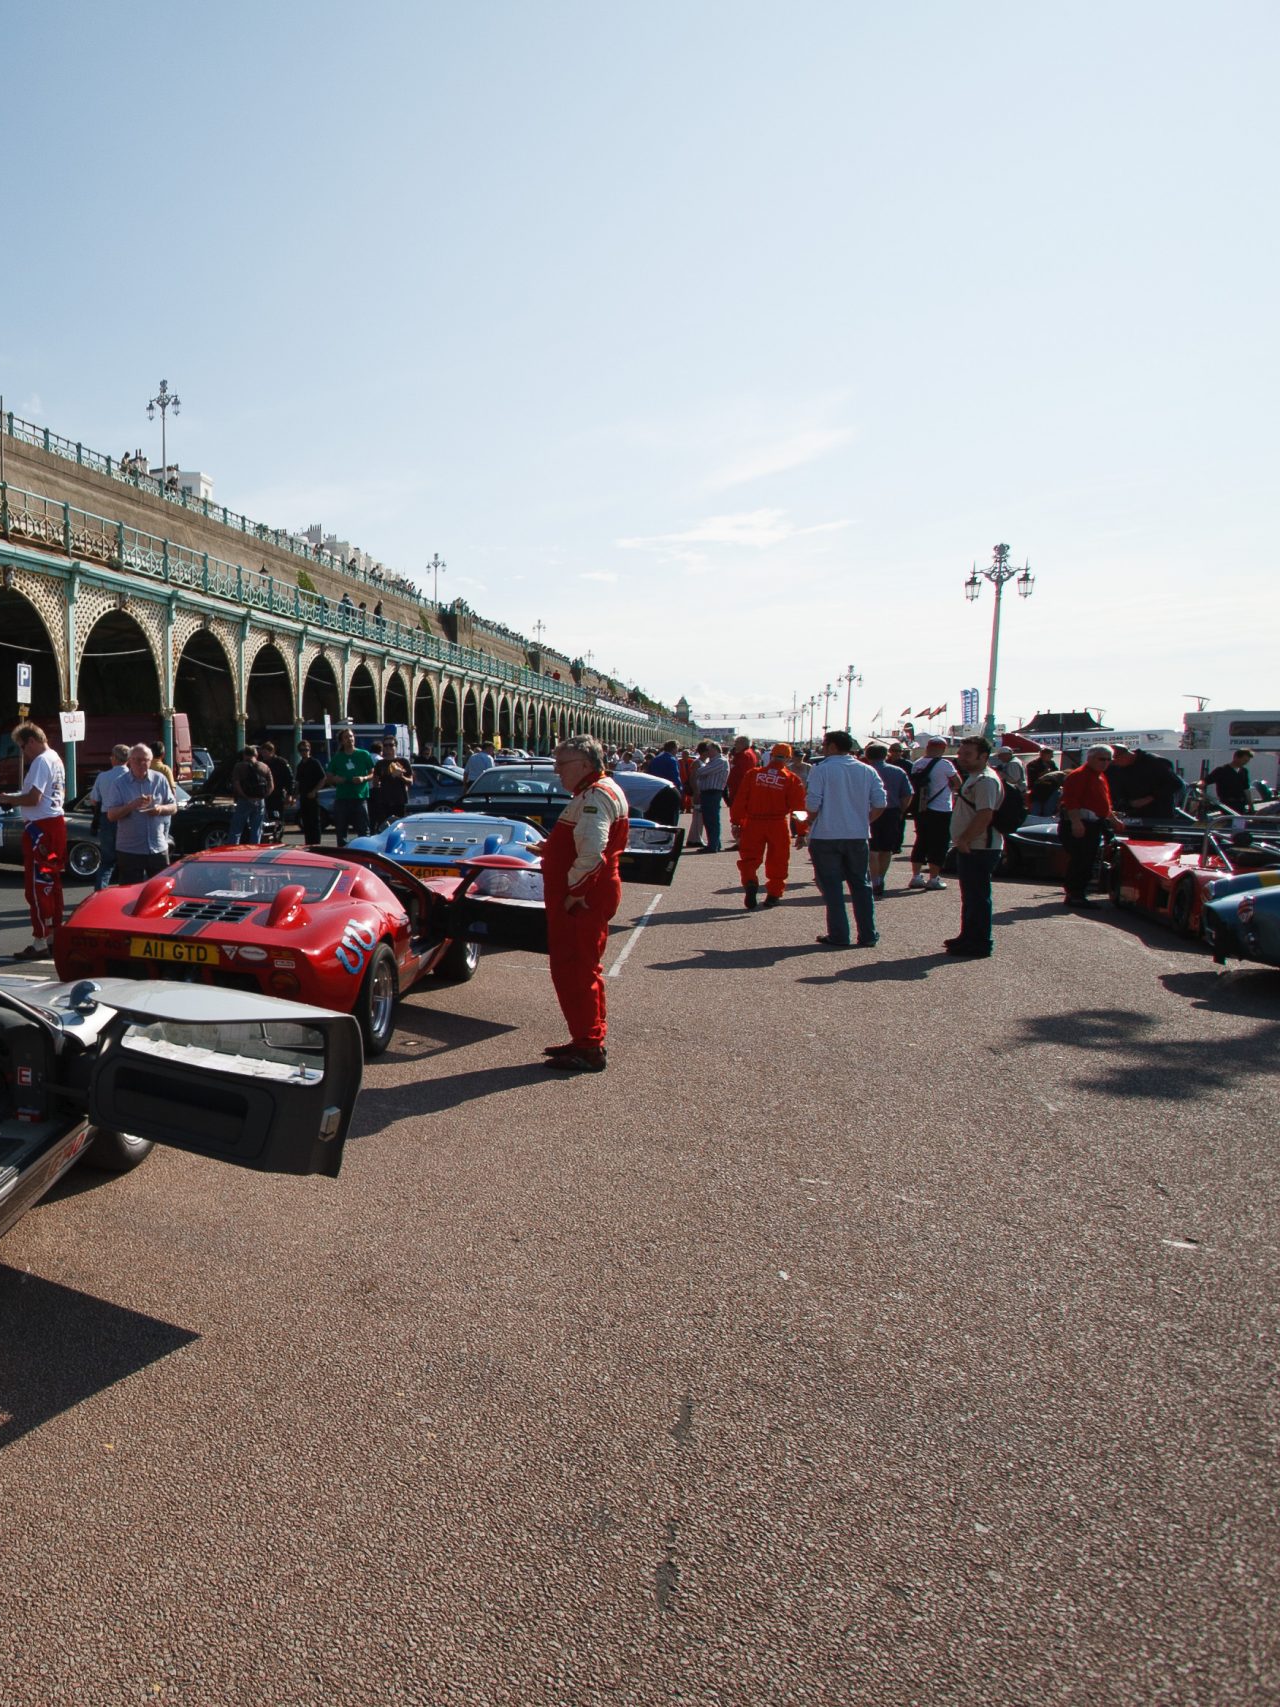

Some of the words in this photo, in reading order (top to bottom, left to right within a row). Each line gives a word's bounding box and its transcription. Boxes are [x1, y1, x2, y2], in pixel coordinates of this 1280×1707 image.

[20, 666, 29, 686] P
[704, 711, 784, 720] START
[172, 944, 208, 962] GTD
